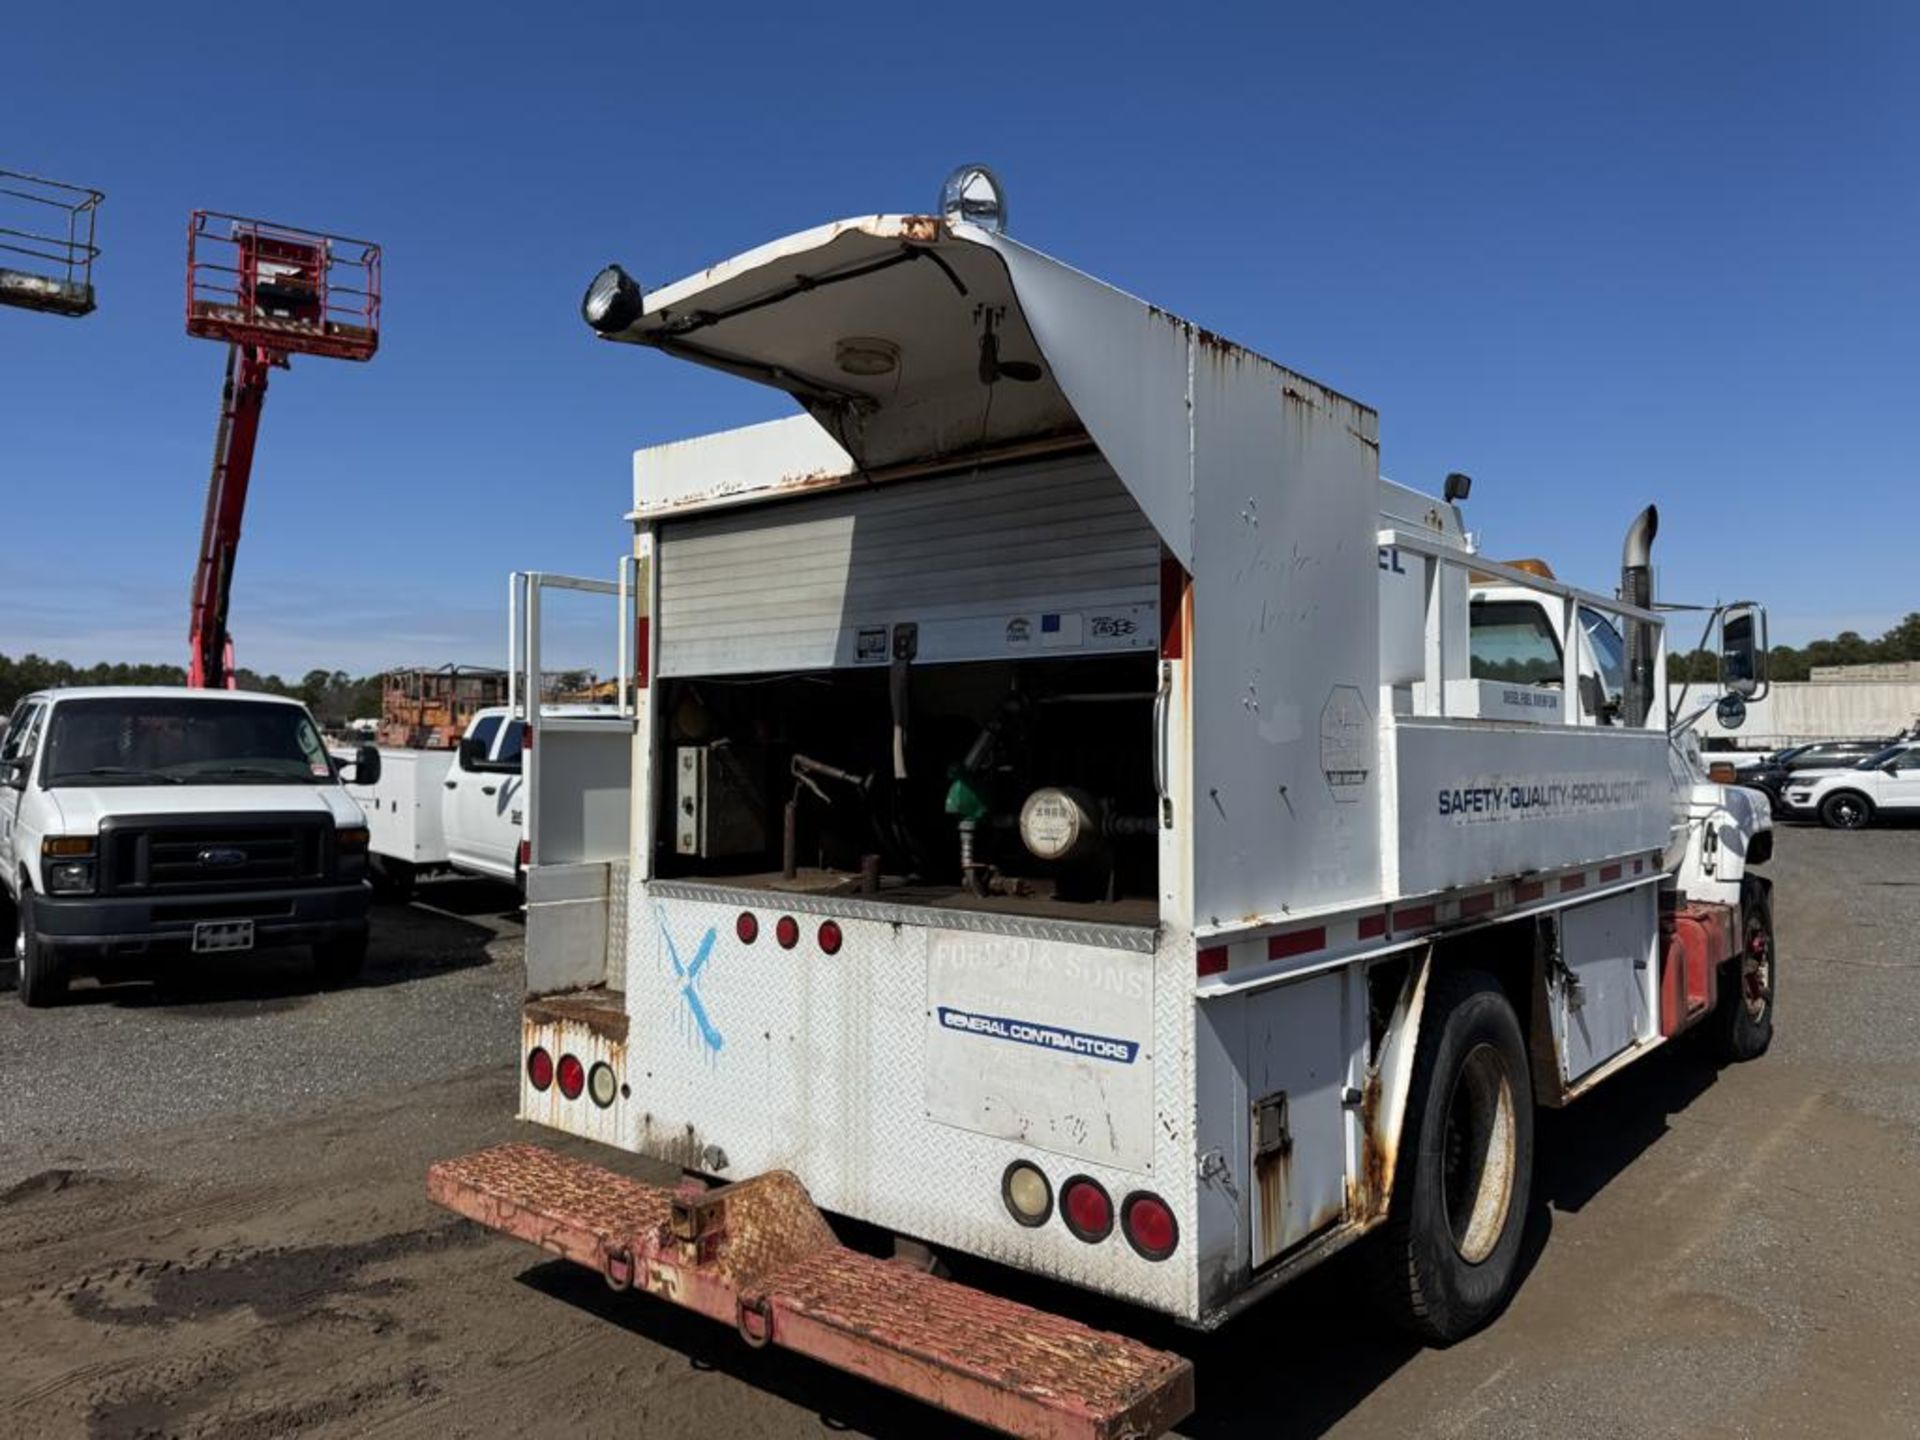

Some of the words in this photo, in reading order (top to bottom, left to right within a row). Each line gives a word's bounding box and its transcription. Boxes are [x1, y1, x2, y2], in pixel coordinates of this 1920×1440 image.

[1439, 788, 1503, 815] SAFETY
[1510, 783, 1567, 809] QUALITY
[945, 1012, 1009, 1036] GENERAL
[1010, 1024, 1129, 1060] CONTRACTORS
